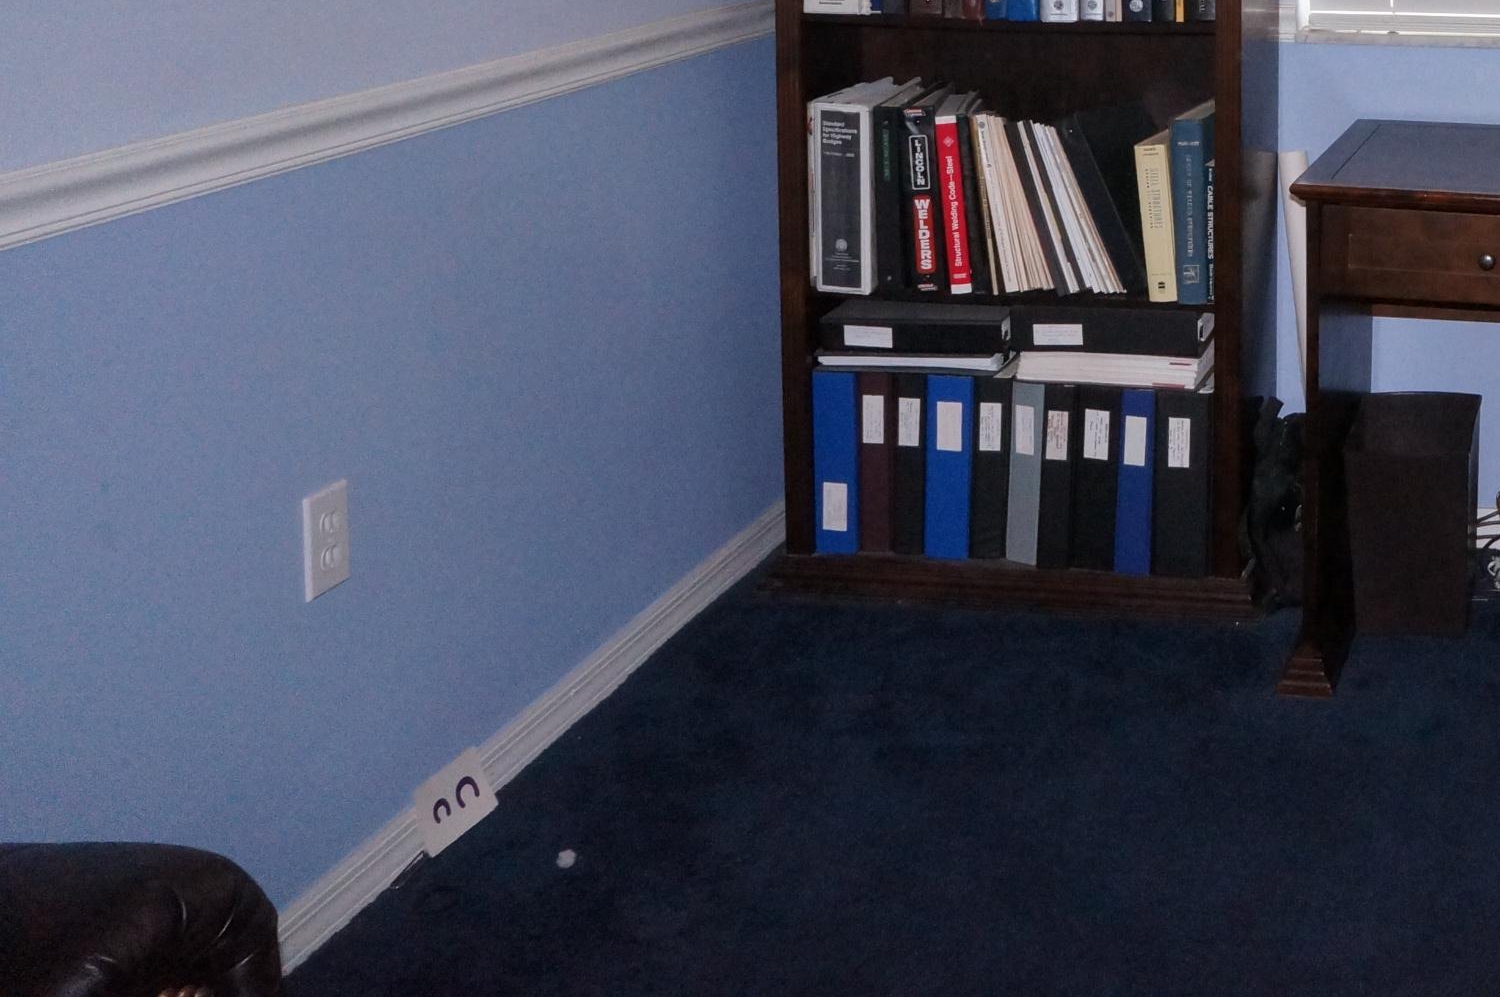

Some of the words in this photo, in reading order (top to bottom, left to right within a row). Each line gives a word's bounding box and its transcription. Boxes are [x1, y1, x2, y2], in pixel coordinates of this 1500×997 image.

[914, 139, 926, 186] LINCOLN
[914, 198, 933, 270] WELDERS
[951, 201, 959, 231] Welding
[954, 232, 963, 267] Structural
